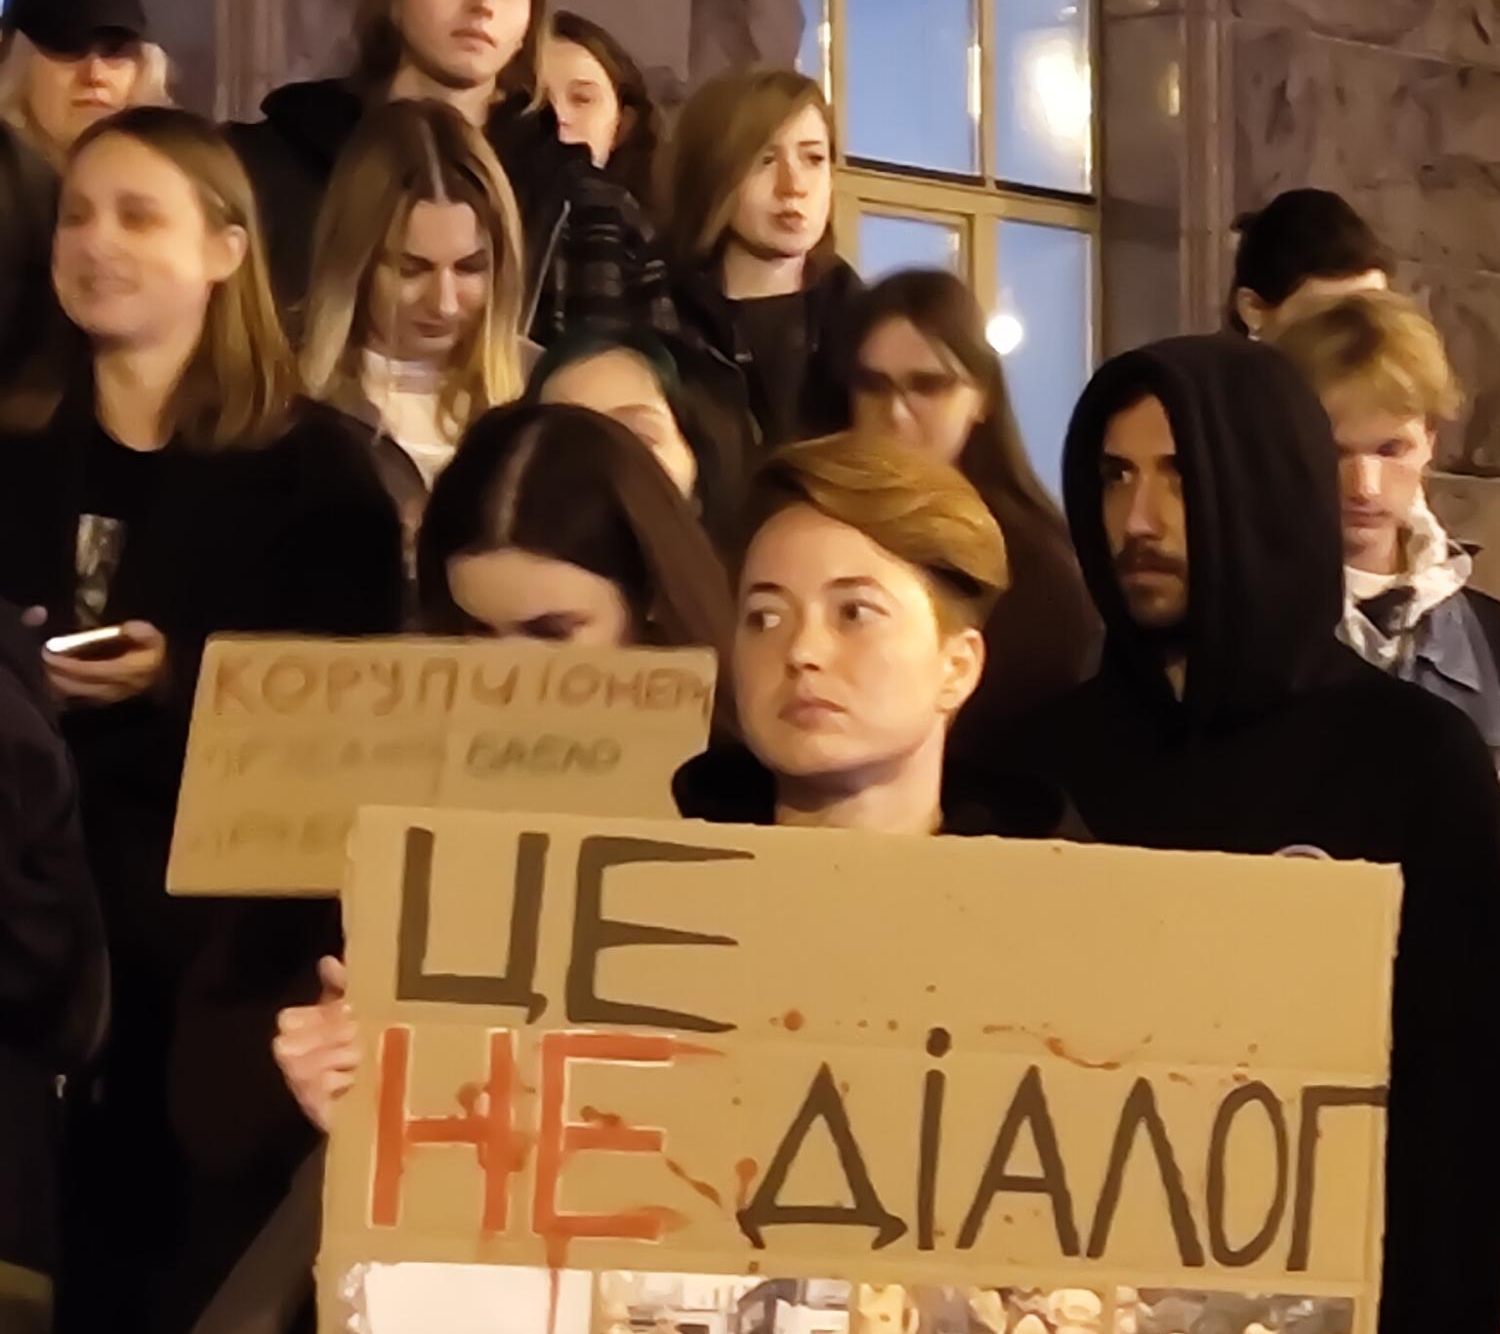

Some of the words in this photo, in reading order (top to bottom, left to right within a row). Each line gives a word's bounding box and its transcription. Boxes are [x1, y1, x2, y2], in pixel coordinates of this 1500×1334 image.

[395, 825, 757, 1034] ЦЕ
[368, 1024, 727, 1242] НЕ
[735, 1024, 1389, 1273] ДІАЛОГ
